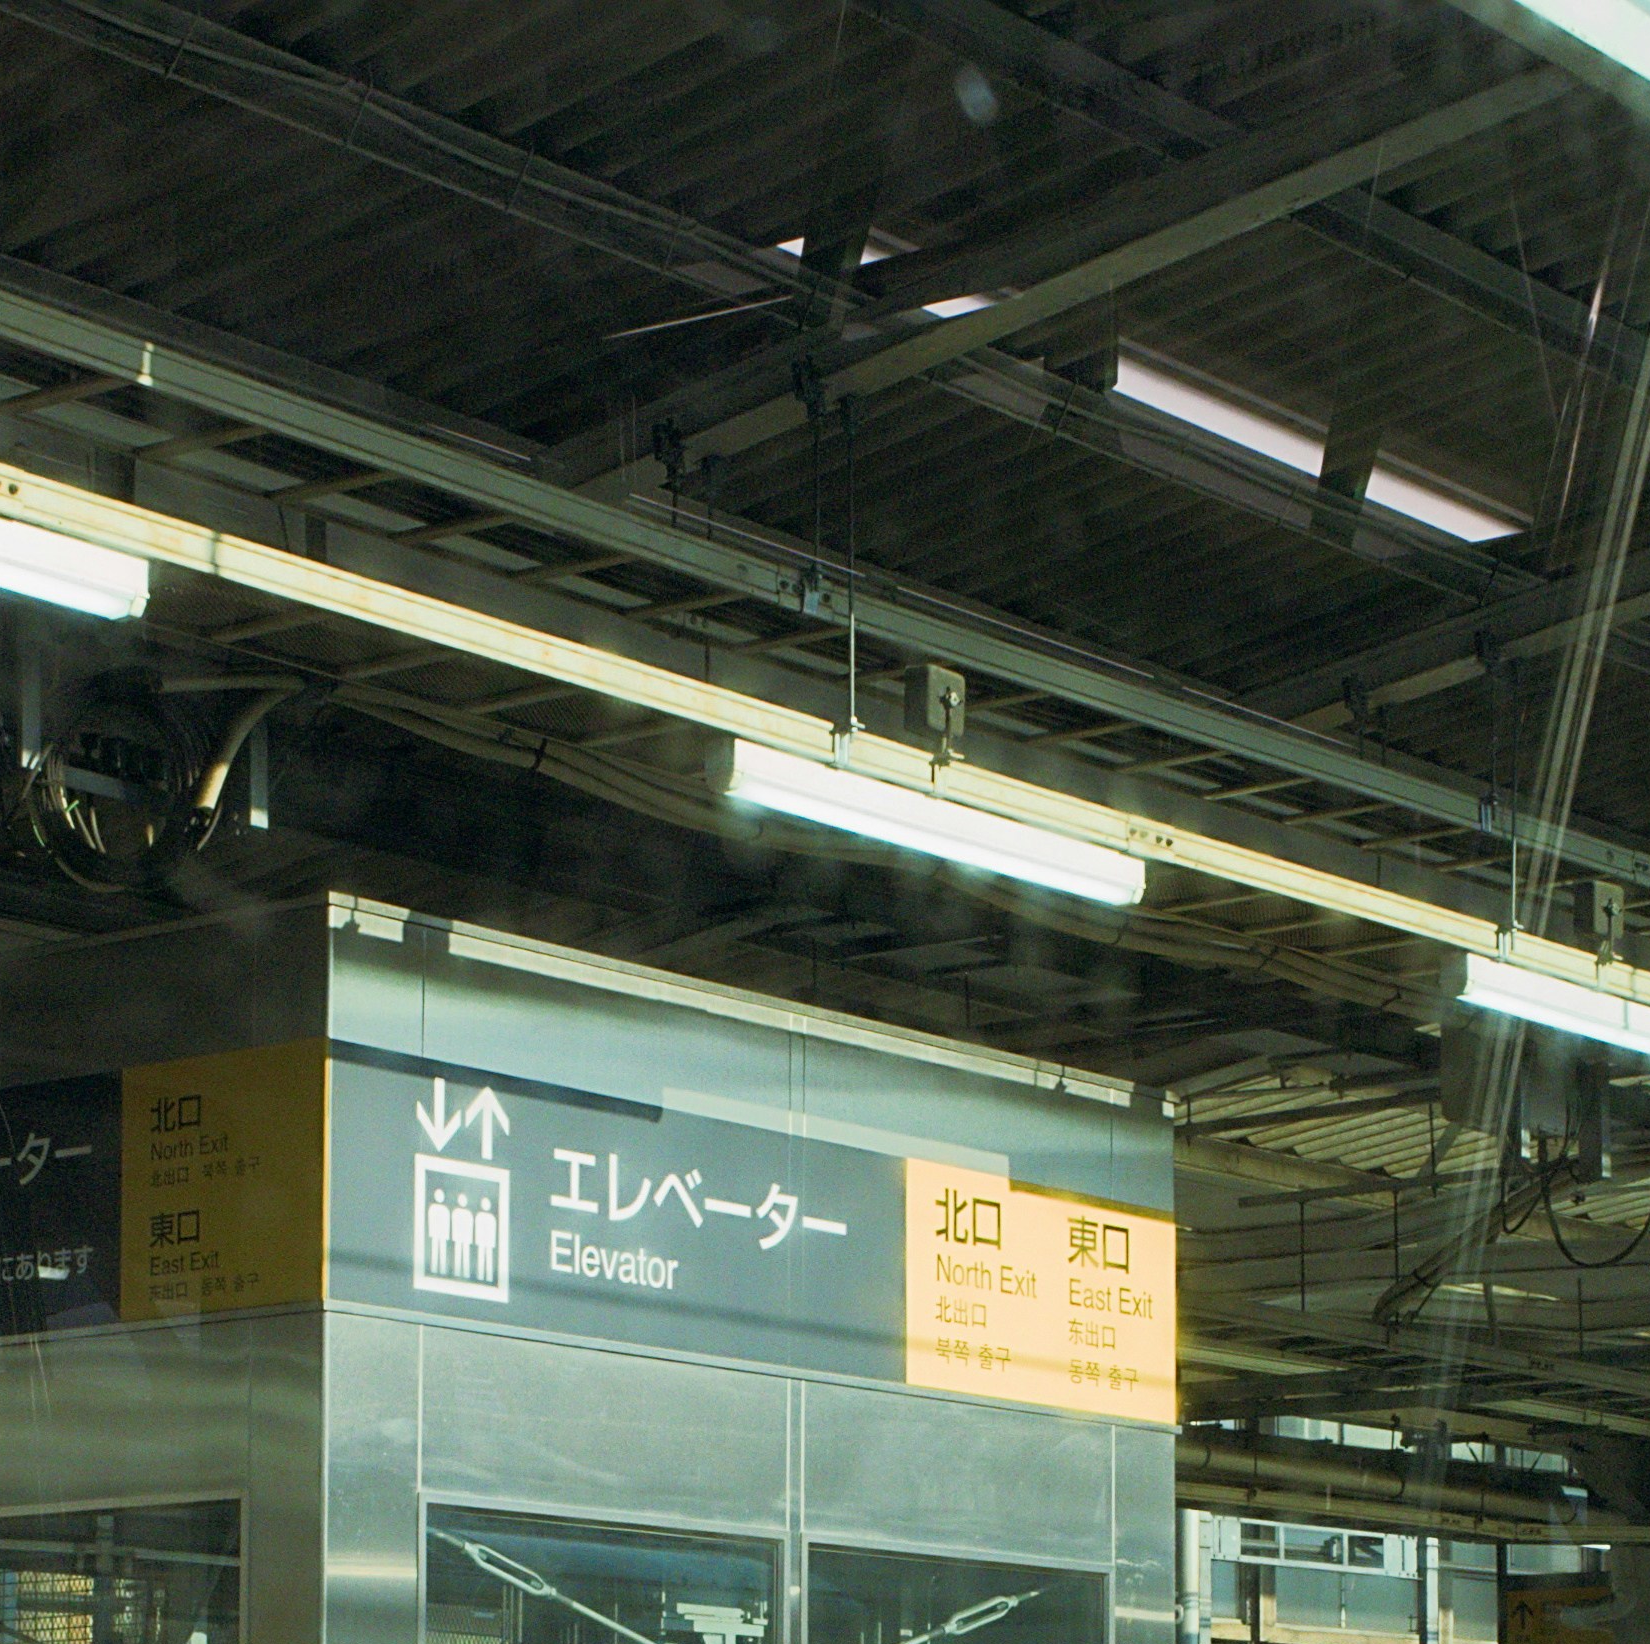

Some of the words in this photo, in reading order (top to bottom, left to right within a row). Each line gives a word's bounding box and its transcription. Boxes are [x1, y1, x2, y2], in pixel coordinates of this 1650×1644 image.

[151, 1094, 201, 1133] 北口
[151, 1140, 194, 1160] North
[200, 1132, 228, 1155] Exit
[551, 1148, 847, 1250] エレベーター
[150, 1210, 199, 1248] 東口
[935, 1188, 1001, 1250] 北口
[151, 1256, 185, 1276] East
[190, 1252, 220, 1271] Exit
[551, 1230, 678, 1289] Elevator
[1068, 1216, 1130, 1274] 東口
[936, 1254, 992, 1291] North
[1000, 1265, 1037, 1298] Exit
[935, 1296, 987, 1328] 北出口
[1069, 1278, 1112, 1312] East
[1119, 1287, 1153, 1320] Exit
[1068, 1318, 1116, 1350] 东出口
[935, 1336, 970, 1366] 북쪽
[978, 1344, 1012, 1372] 출구
[1068, 1359, 1101, 1388] 동쪽
[1108, 1364, 1139, 1392] 출구
